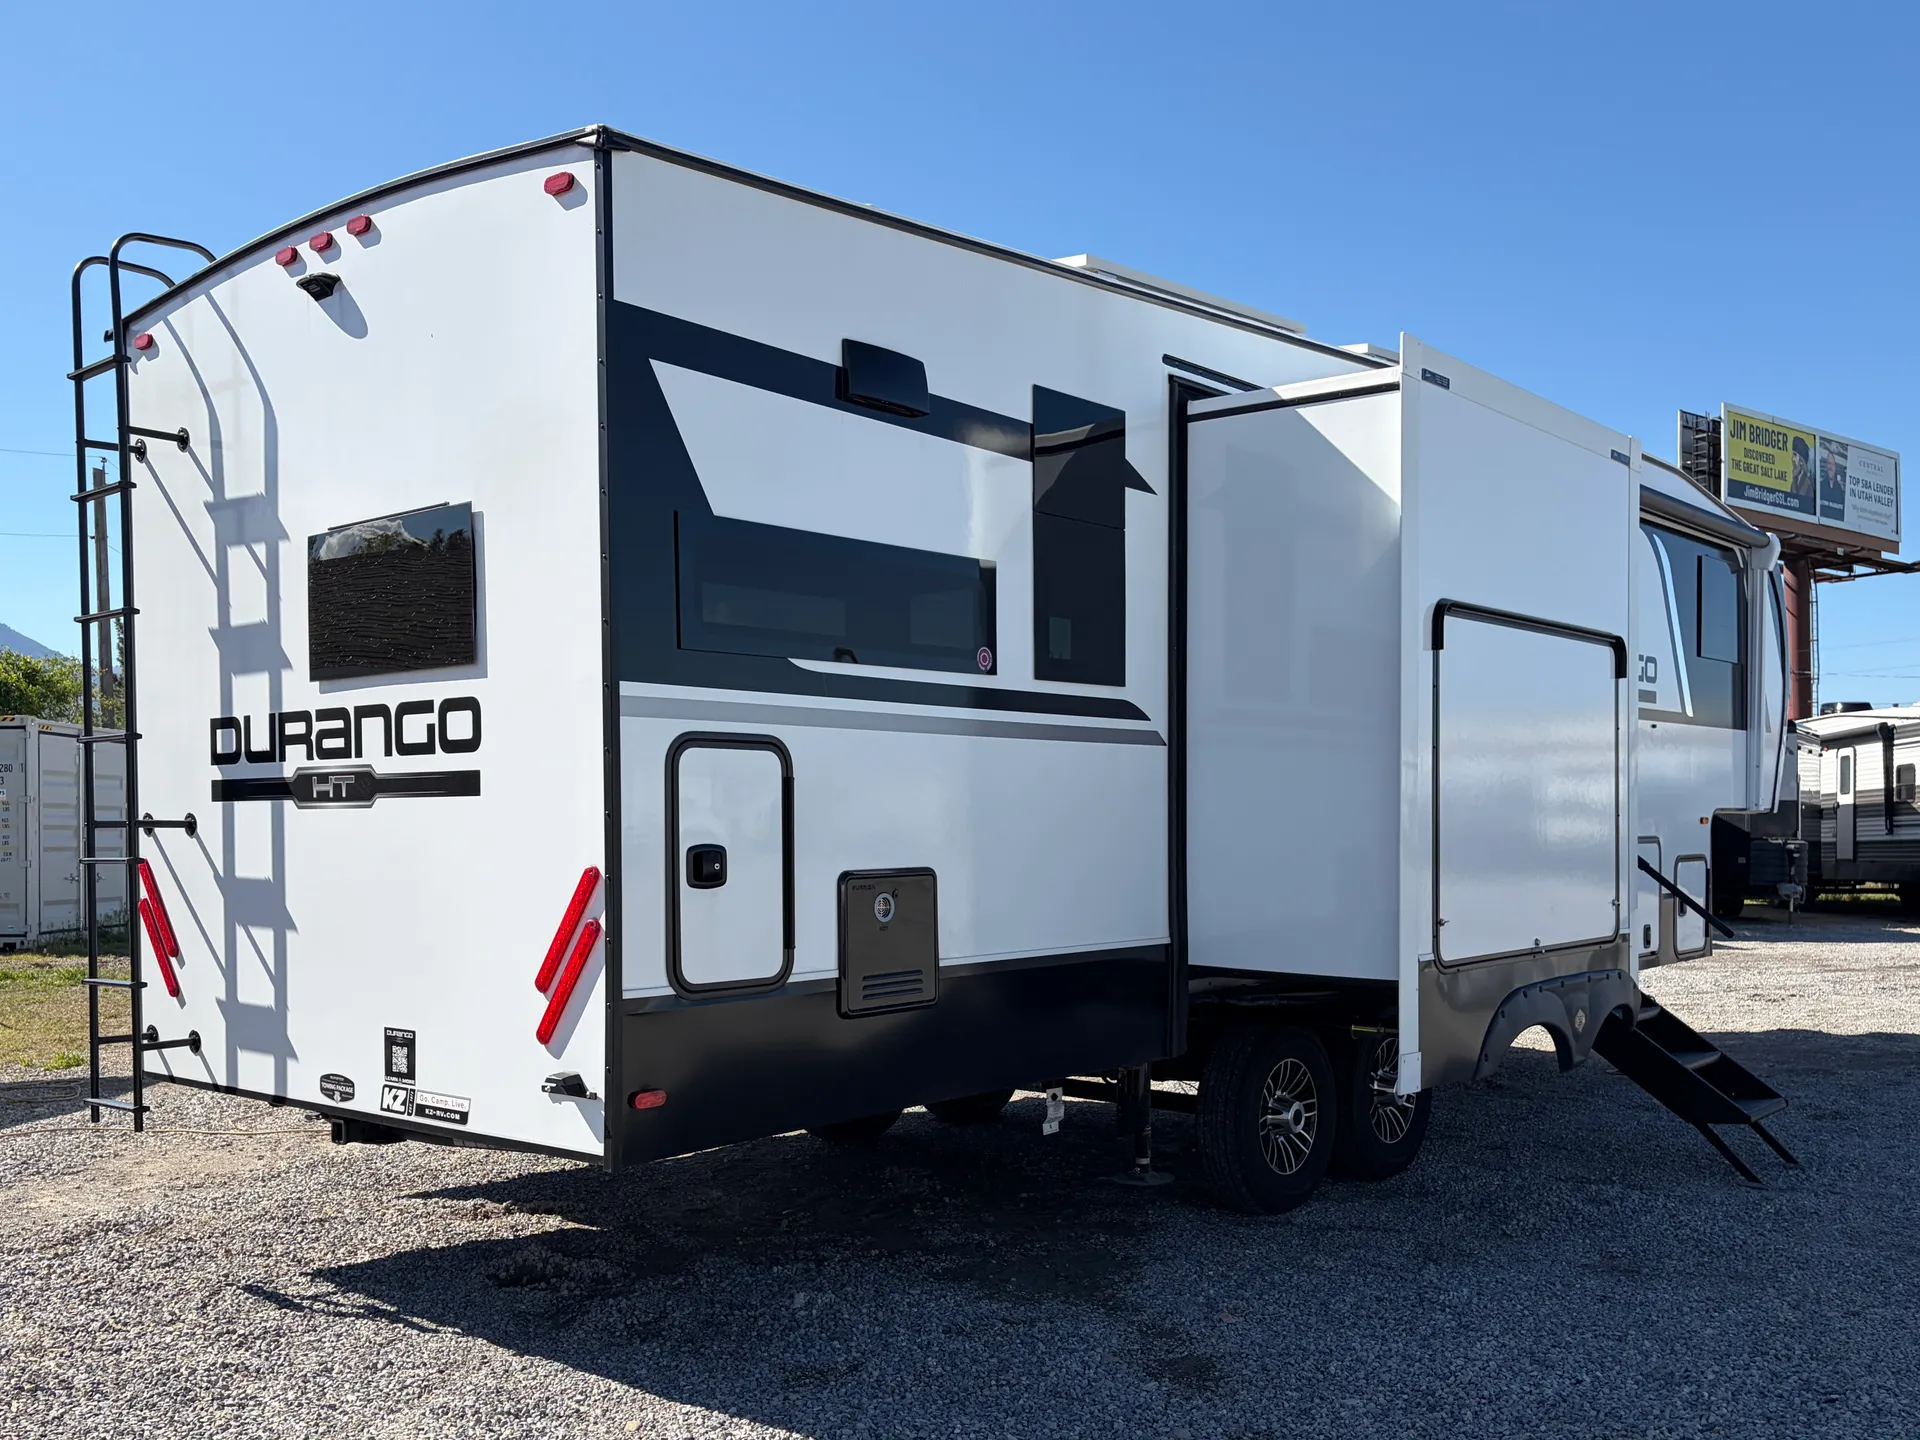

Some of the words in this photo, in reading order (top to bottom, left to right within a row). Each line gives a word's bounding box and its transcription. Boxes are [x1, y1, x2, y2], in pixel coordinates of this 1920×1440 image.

[1730, 419, 1746, 441] JIM
[1749, 424, 1788, 452] BRIDGER
[1744, 447, 1775, 465] DISCOVERED
[1731, 459, 1742, 471] THE
[1743, 461, 1759, 476] GREAT
[1761, 465, 1773, 479] SALT
[1774, 468, 1788, 482] LAKE
[1859, 460, 1884, 473] CENTRAL
[1849, 475, 1860, 487] TOP
[1861, 479, 1872, 491] SBA
[1873, 483, 1894, 496] LENDER
[1849, 488, 1856, 498] IN
[1857, 490, 1873, 503] UTAH
[1873, 495, 1894, 508] VALLEY
[312, 775, 355, 798] HT
[382, 1087, 407, 1112] KZ
[419, 1094, 429, 1103] Go.
[431, 1096, 450, 1107] Camp.
[451, 1099, 467, 1109] Live.
[425, 1108, 460, 1120] KZ-RV.COM
